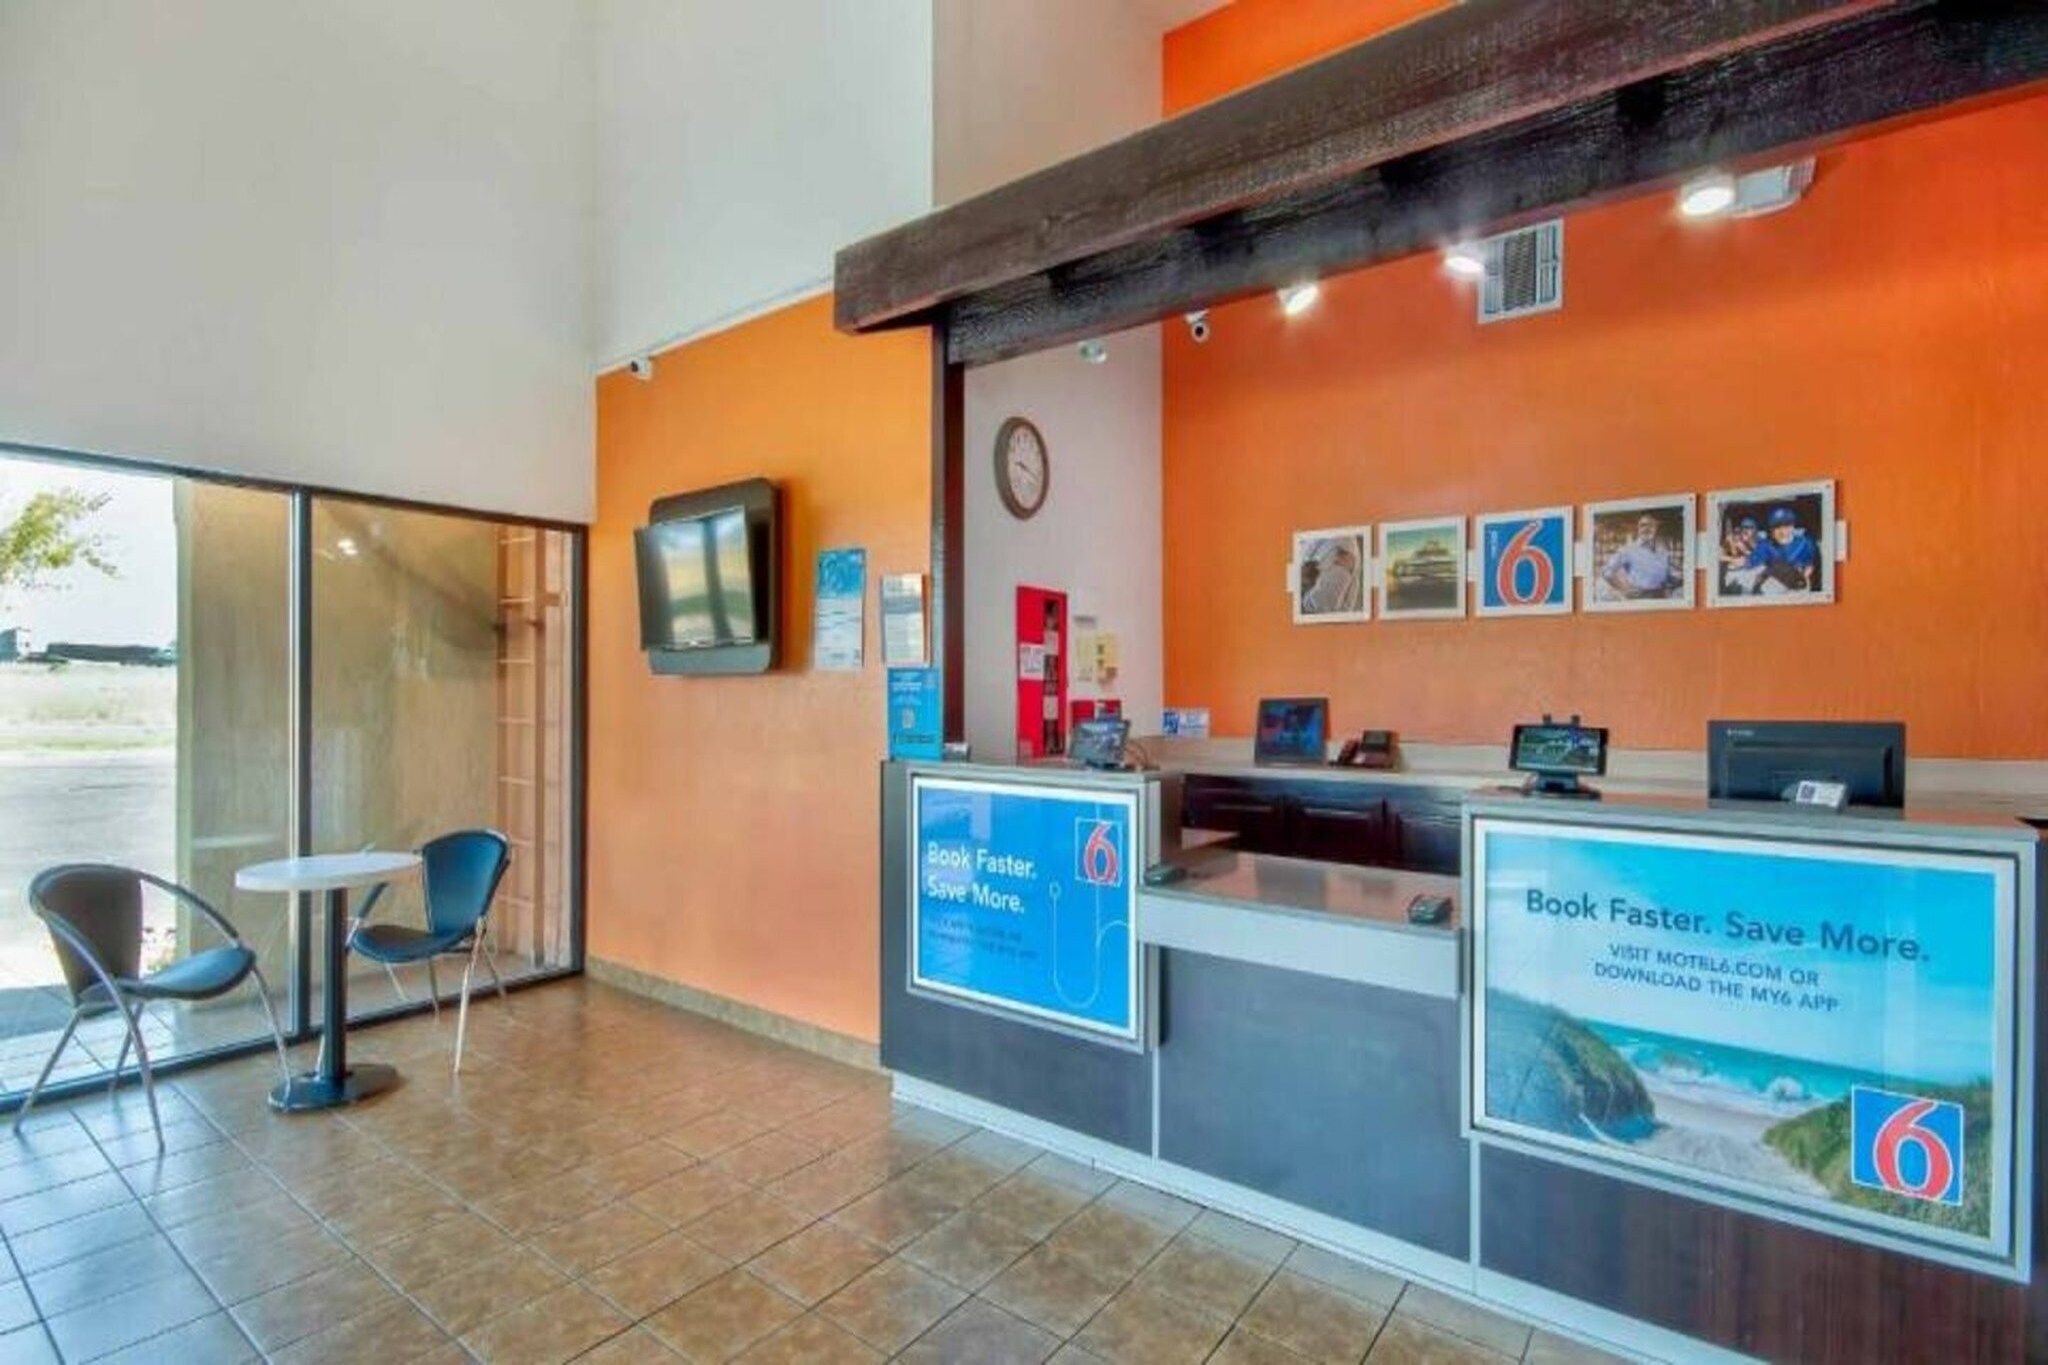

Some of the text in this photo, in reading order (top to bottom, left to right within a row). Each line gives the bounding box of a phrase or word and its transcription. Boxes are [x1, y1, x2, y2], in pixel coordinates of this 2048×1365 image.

[1497, 520, 1553, 608] 6
[927, 841, 1037, 880] Book Faster.
[1084, 821, 1120, 885] 6
[927, 874, 1025, 914] Save More.
[1526, 888, 1930, 962] Book Faster. Save More.
[1595, 962, 1839, 1012] DOWNLOAD THE MY6 APP
[1609, 943, 1819, 986] VISIT MOTEL6.COM OR
[1873, 1098, 1953, 1201] 6
